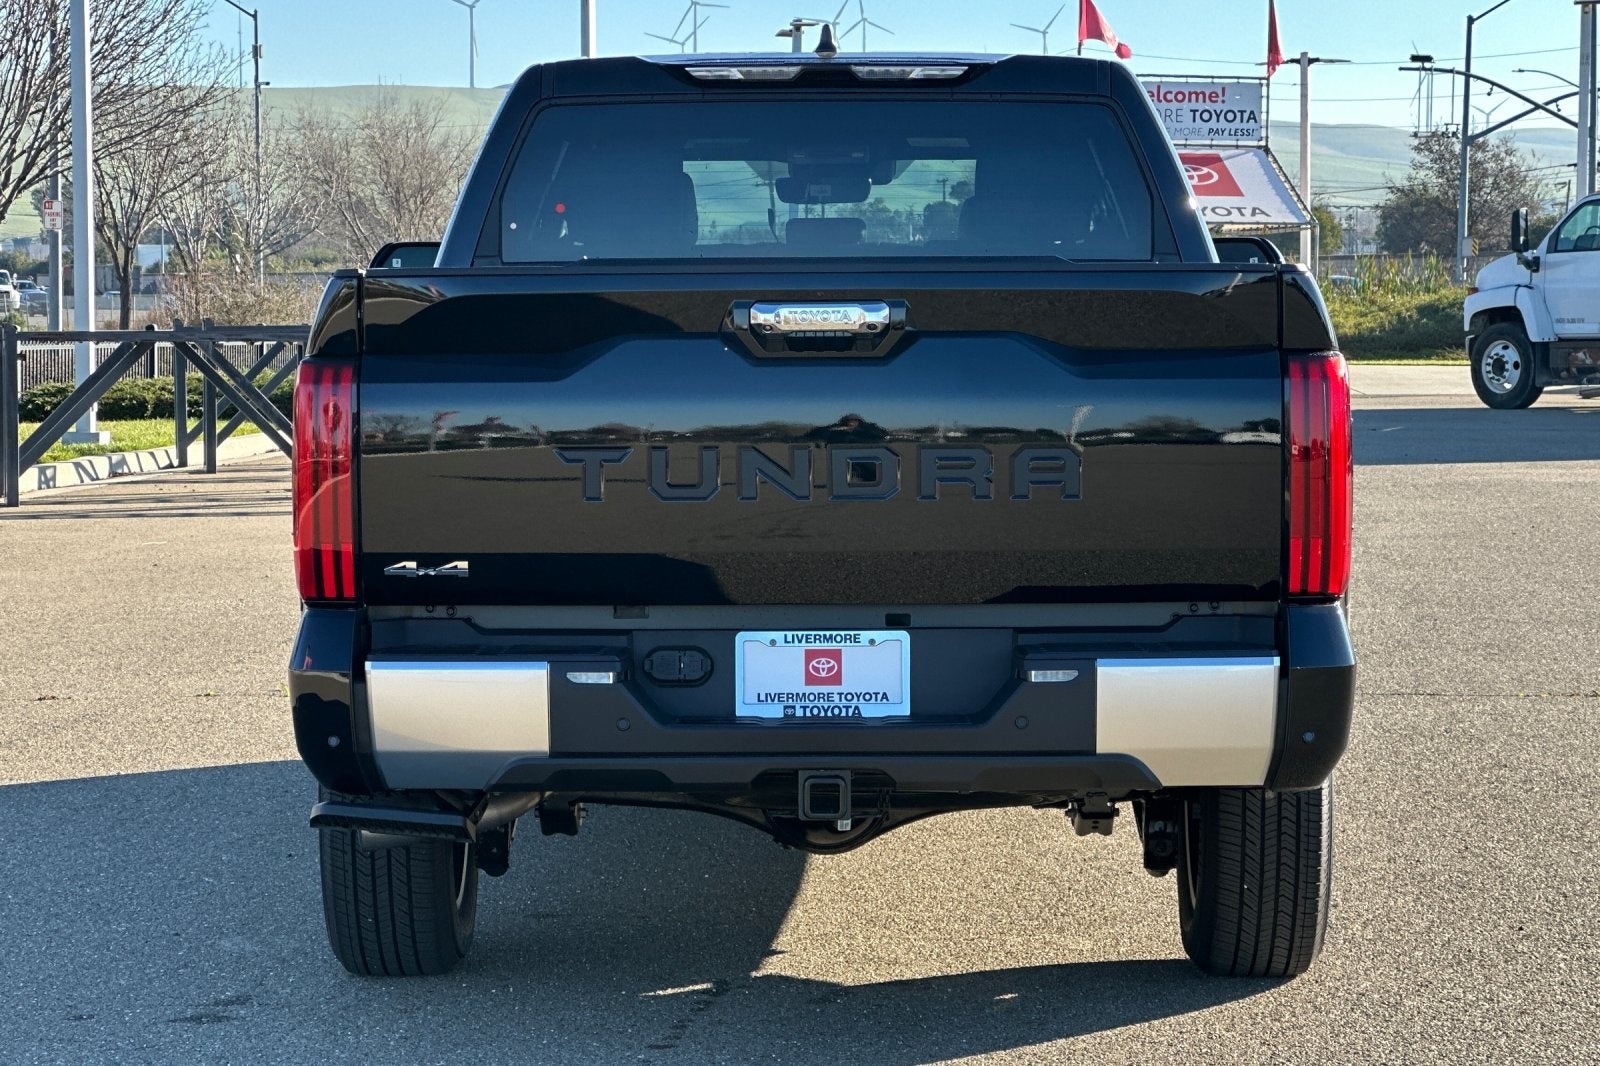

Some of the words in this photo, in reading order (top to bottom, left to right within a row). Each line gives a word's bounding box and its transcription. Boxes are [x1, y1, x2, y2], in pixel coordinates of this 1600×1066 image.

[1189, 109, 1258, 123] TOYOTA
[1173, 127, 1205, 137] MORE,
[1207, 128, 1226, 137] PAY
[1228, 128, 1255, 137] LESS!
[788, 309, 852, 323] TOYOTA
[553, 445, 1083, 502] TUNDRA
[783, 633, 862, 644] LIVERMORE
[757, 692, 835, 703] LIVERMORE
[838, 692, 889, 702] TOYOTA
[799, 705, 862, 717] TOYOTA
